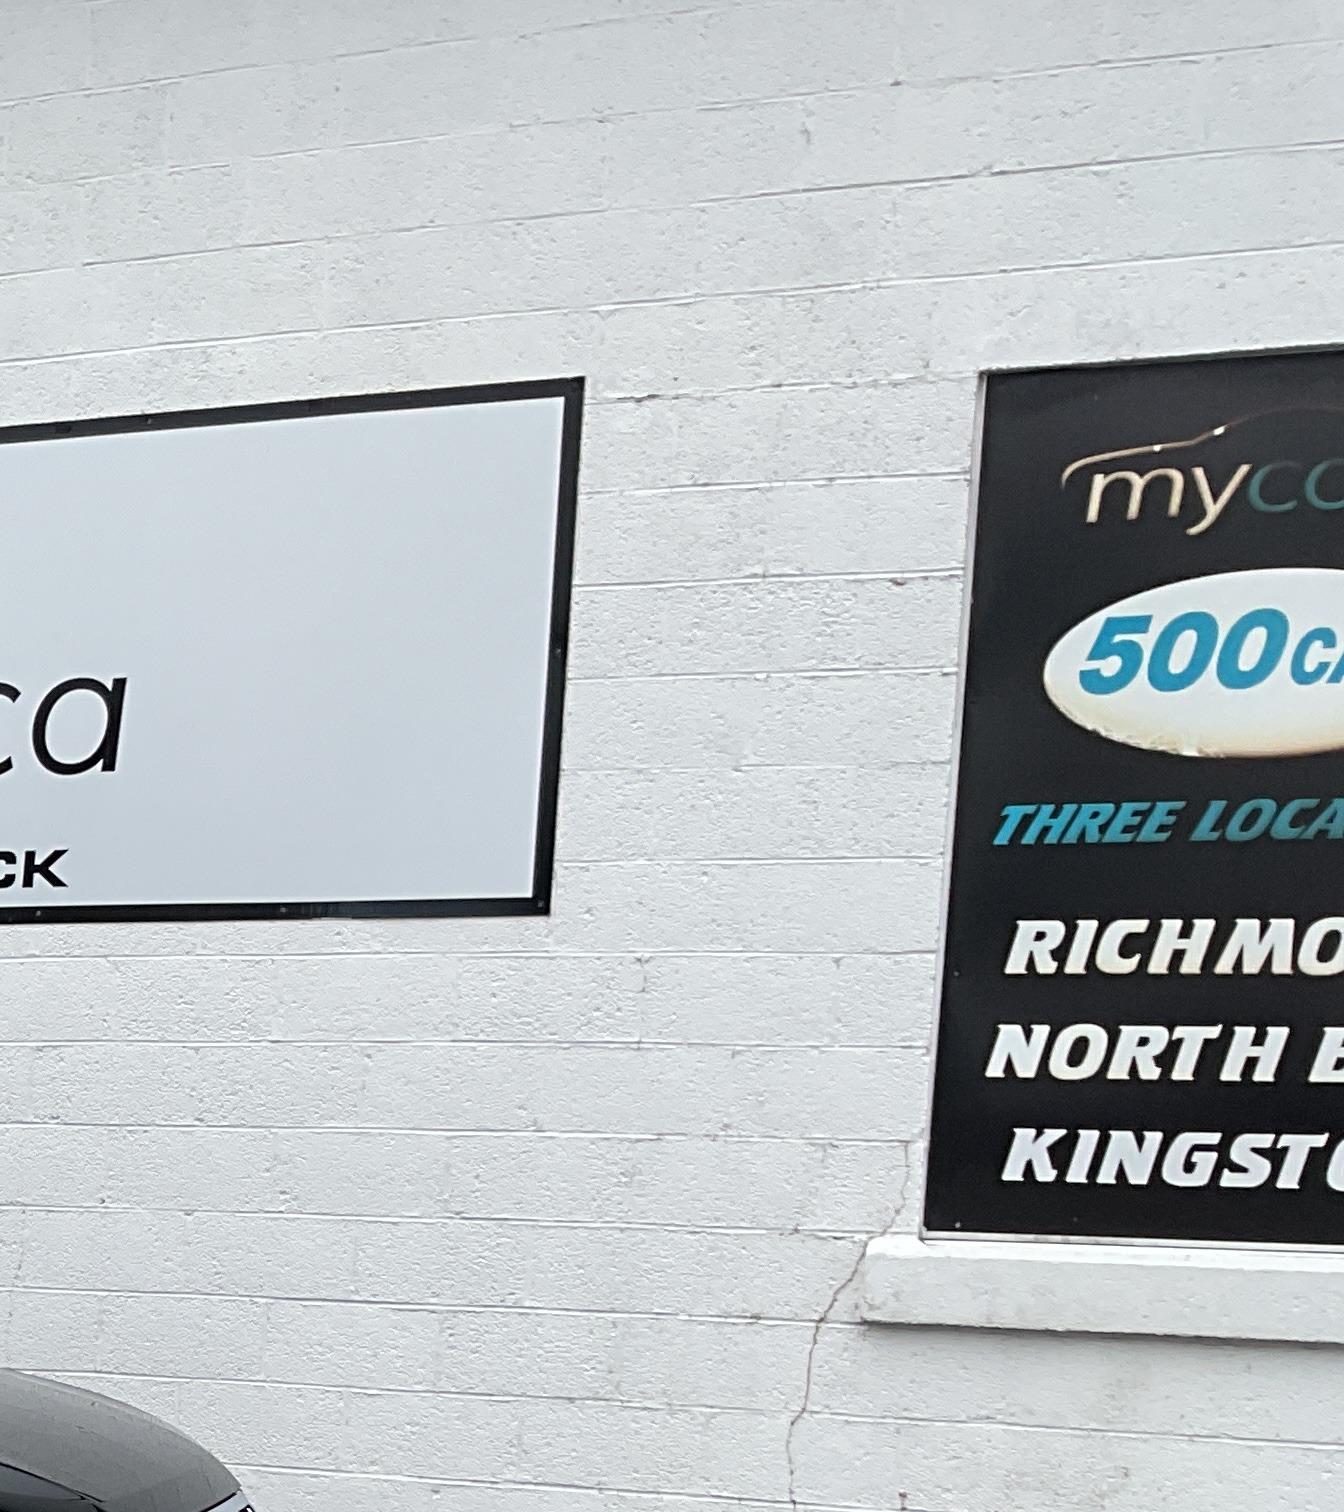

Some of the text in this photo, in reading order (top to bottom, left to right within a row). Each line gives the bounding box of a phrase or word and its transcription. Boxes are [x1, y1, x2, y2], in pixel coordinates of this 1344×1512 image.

[1079, 607, 1290, 696] 500
[992, 800, 1187, 846] THREE
[984, 1023, 1290, 1082] NORTH
